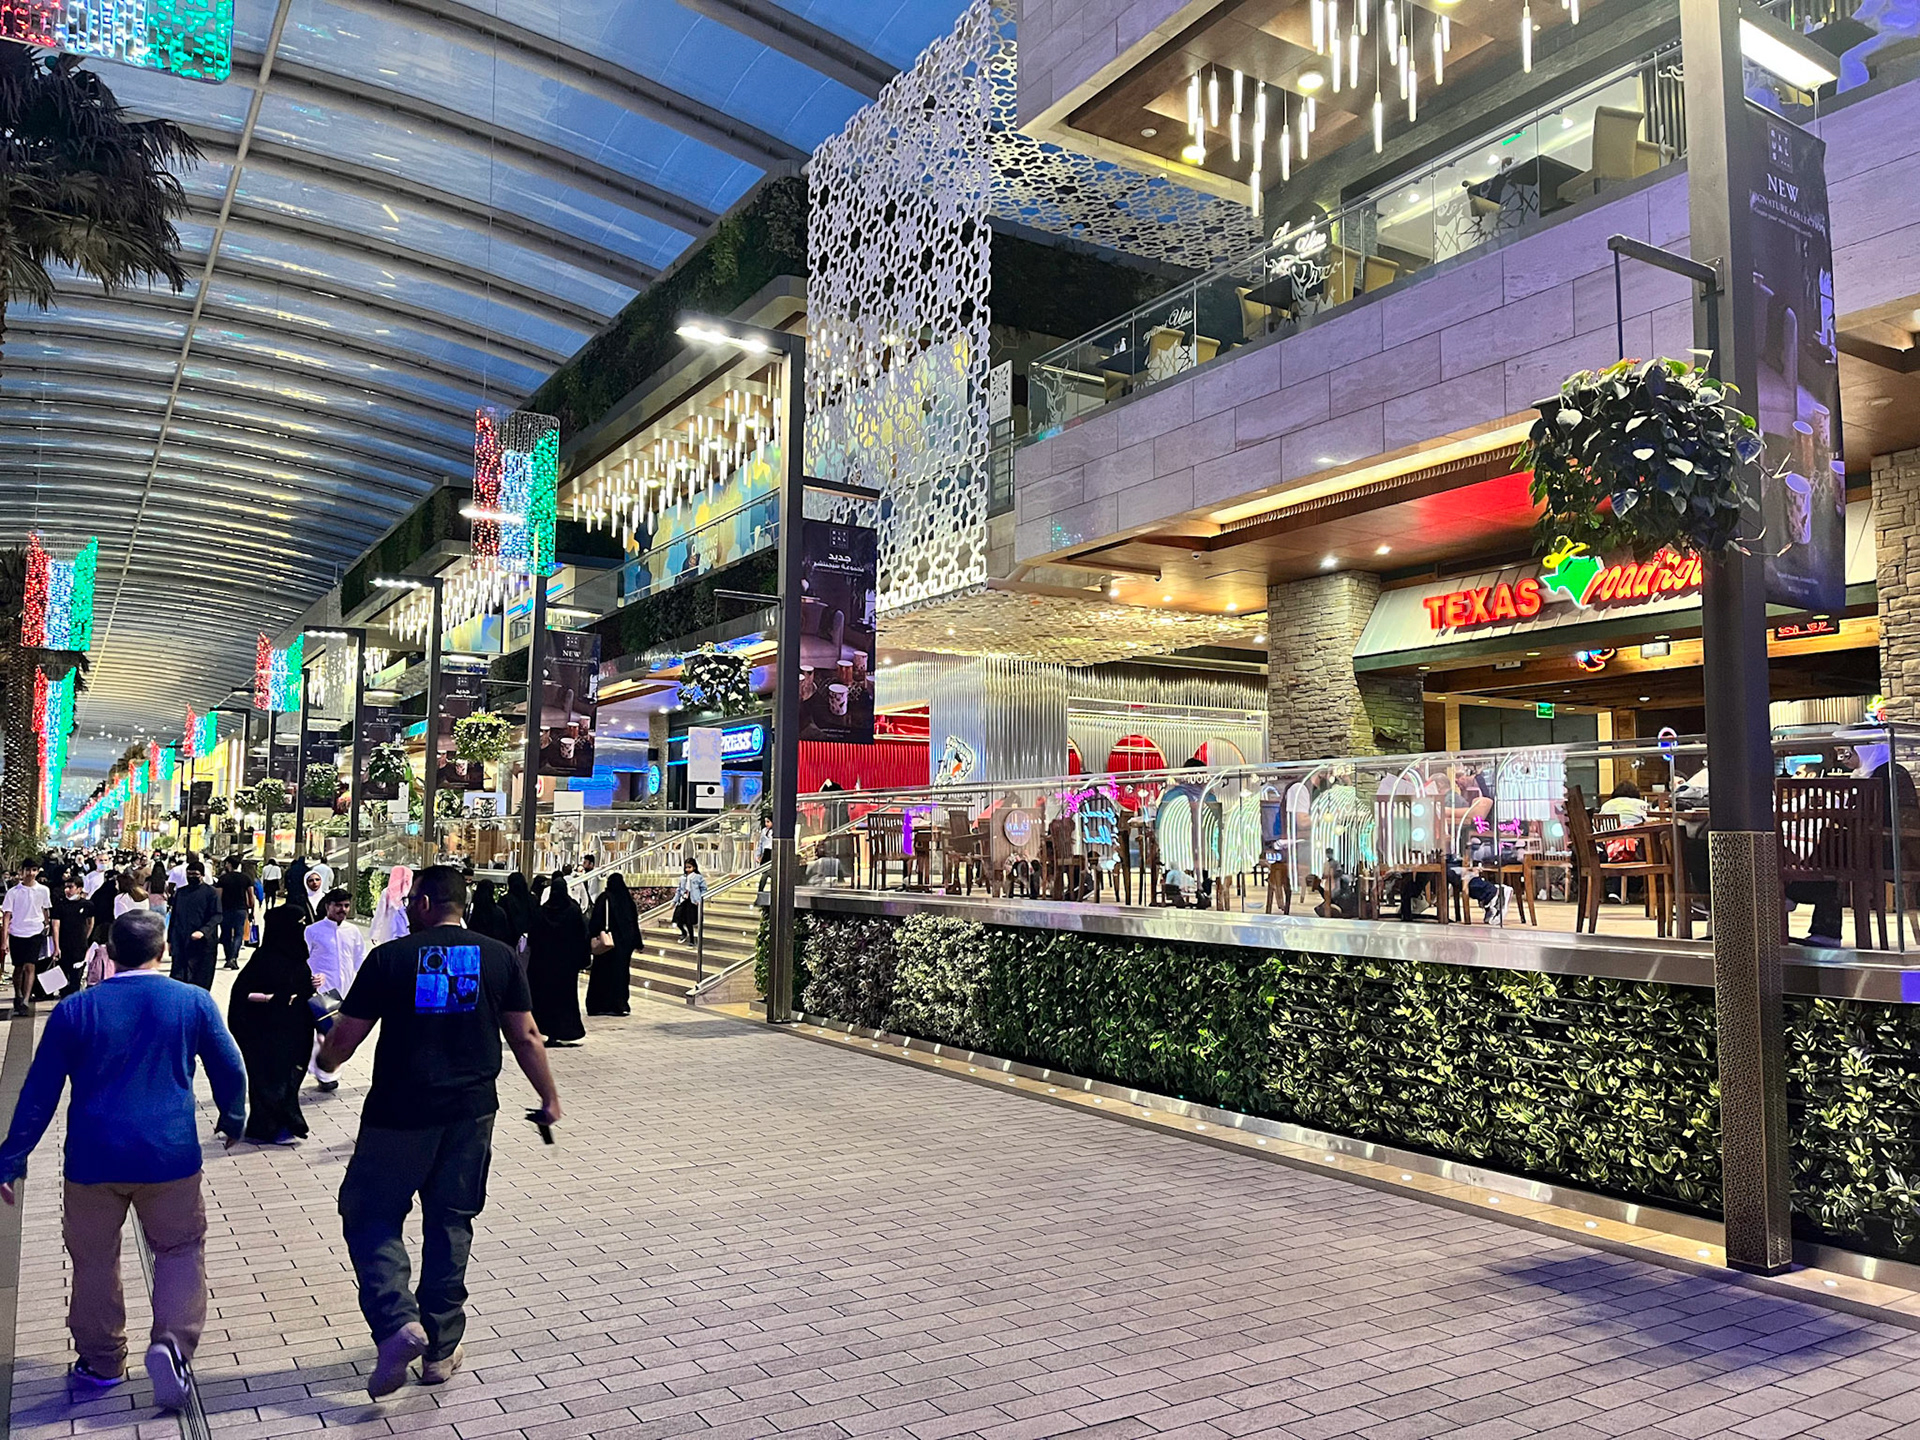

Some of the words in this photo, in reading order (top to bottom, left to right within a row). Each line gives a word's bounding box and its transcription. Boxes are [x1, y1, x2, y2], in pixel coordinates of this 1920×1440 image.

[1766, 173, 1799, 203] NEW
[828, 553, 852, 564] جديد
[1423, 578, 1544, 630] TEXAS
[563, 650, 581, 658] NEW
